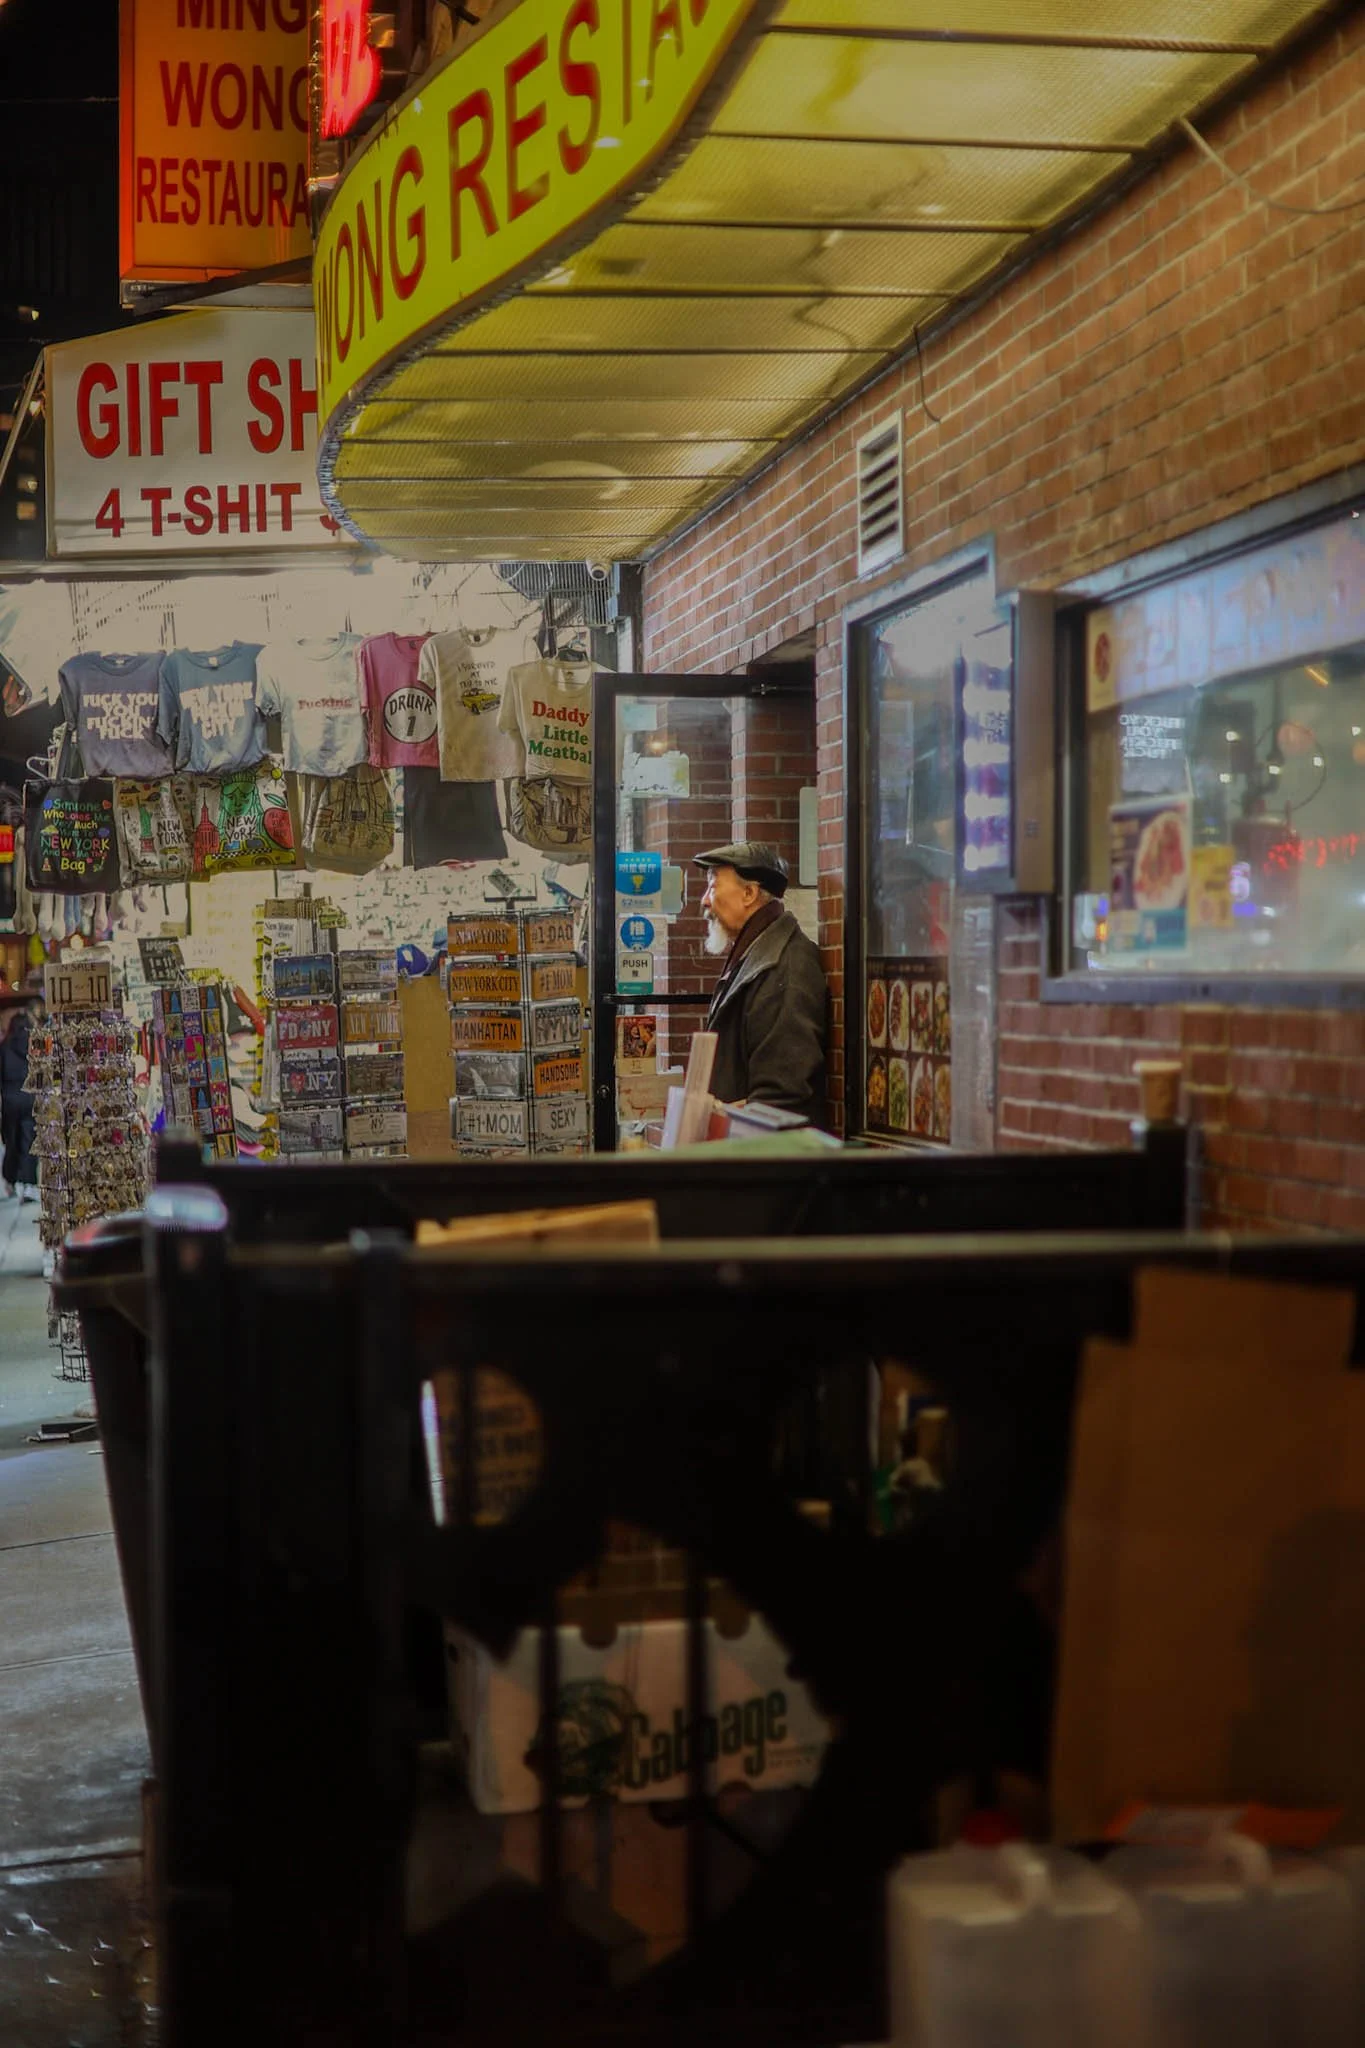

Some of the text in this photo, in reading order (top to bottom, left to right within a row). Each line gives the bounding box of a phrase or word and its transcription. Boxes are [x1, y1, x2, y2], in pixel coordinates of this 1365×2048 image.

[447, 0, 710, 262] RESTA
[77, 361, 223, 459] GIFT
[95, 487, 125, 538] 4
[140, 483, 302, 537] T-SHIT
[83, 693, 158, 707] FUCK YOU
[389, 694, 433, 716] DRUNK
[99, 727, 145, 740] FUCK
[406, 715, 416, 737] 1
[543, 725, 588, 745] Little
[43, 809, 65, 820] Who
[226, 815, 257, 830] NEW
[157, 820, 181, 831] NEW
[40, 834, 110, 850] NEW YORK
[157, 831, 186, 846] YORK
[226, 827, 257, 843] YORK
[60, 857, 86, 874] Bag
[479, 928, 510, 945] YORK
[622, 959, 648, 968] PUSH
[474, 976, 498, 992] YORK
[498, 976, 519, 992] CITY
[454, 1022, 517, 1041] MANHATTAN
[282, 1071, 337, 1092] I NY
[540, 1062, 580, 1085] HANDSOME
[370, 1118, 385, 1130] NY
[485, 1112, 522, 1135] MOM
[550, 1108, 577, 1130] SEXY
